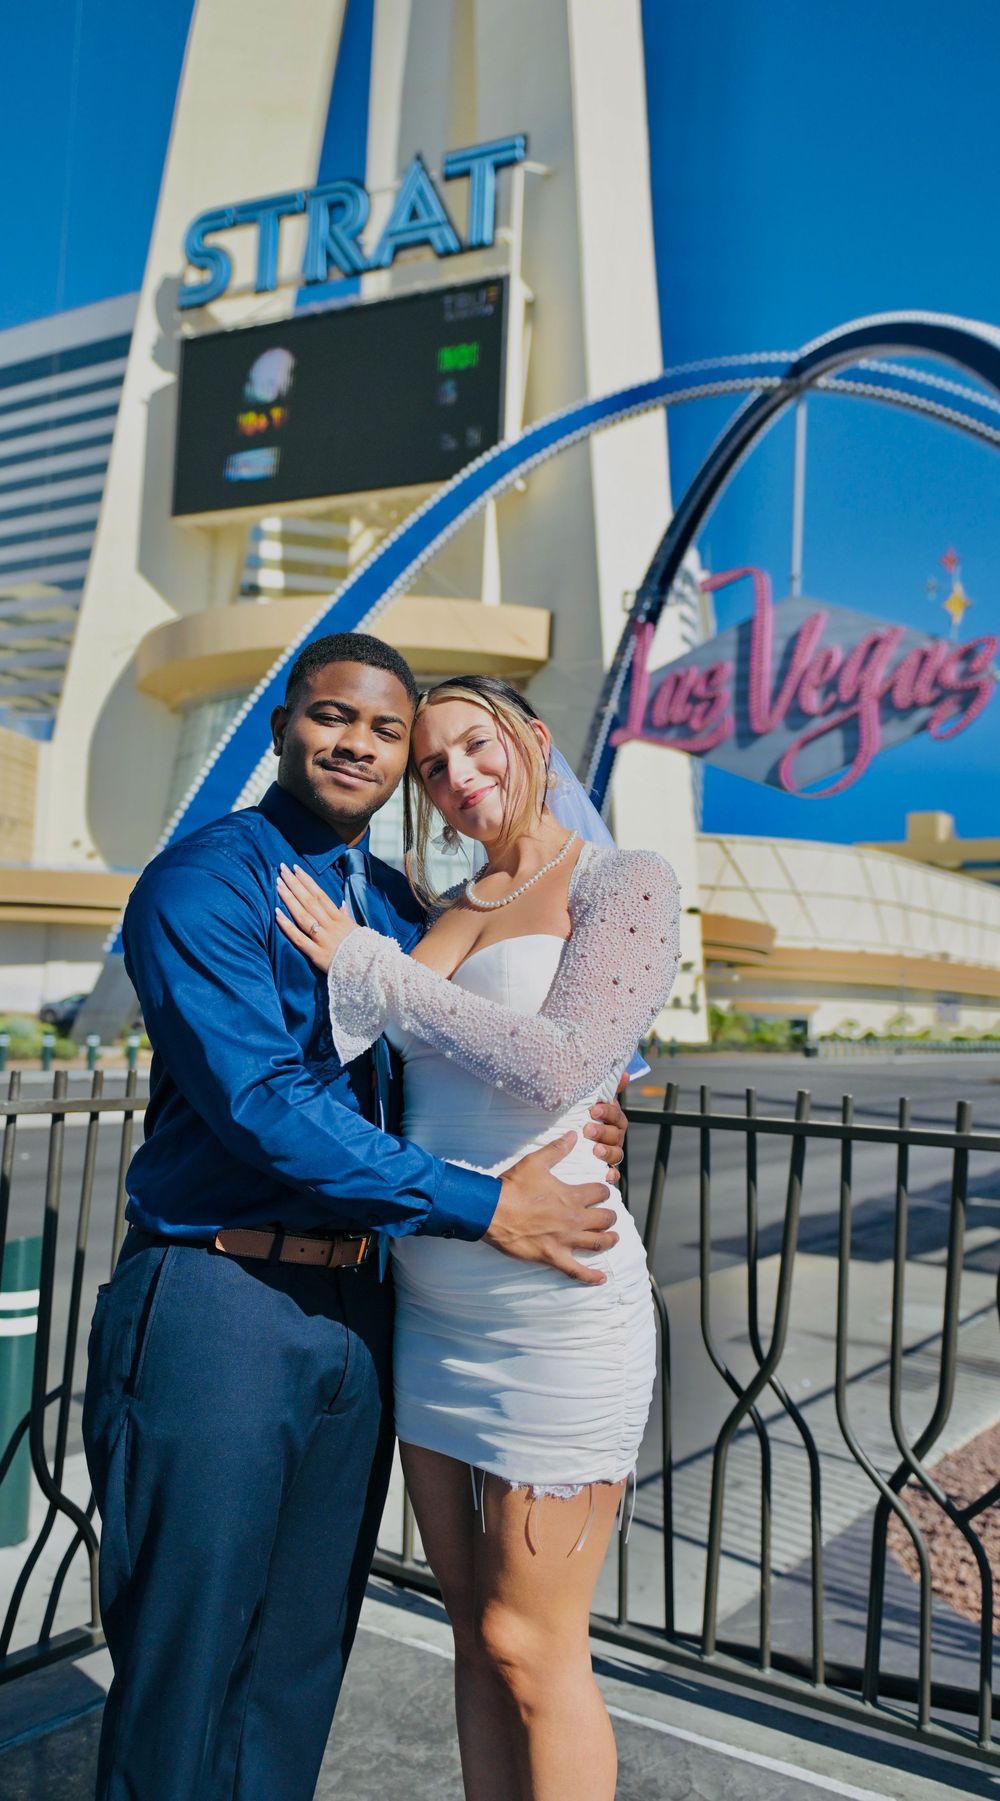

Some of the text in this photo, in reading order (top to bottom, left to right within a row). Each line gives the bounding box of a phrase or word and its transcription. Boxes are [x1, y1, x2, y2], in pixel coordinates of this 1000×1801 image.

[178, 134, 526, 309] STRAT
[609, 566, 999, 798] Las Vegas
